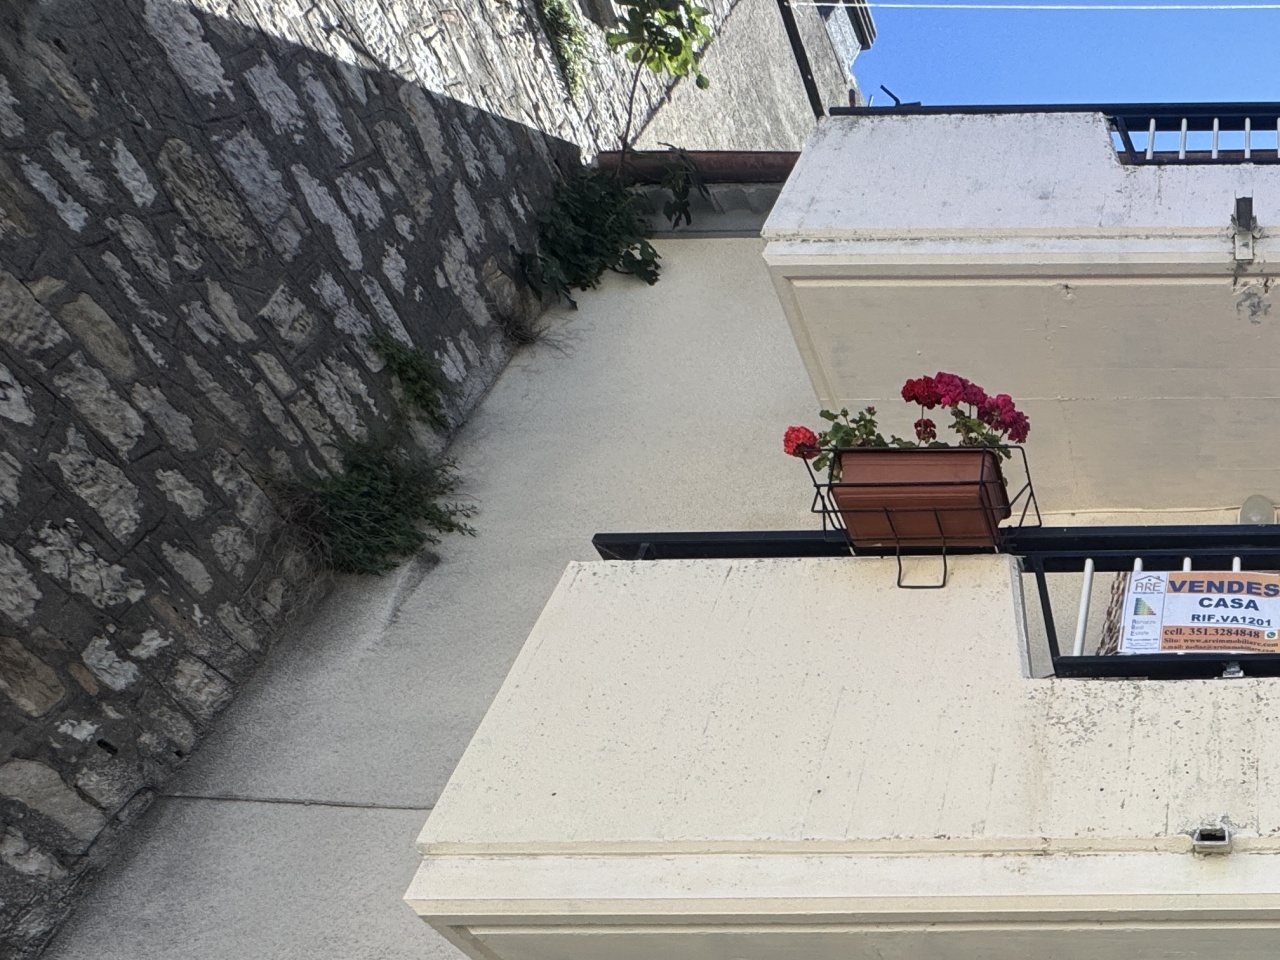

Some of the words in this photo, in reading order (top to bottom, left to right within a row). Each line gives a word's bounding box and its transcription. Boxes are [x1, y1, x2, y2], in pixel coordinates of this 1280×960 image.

[1135, 582, 1162, 591] ARE
[1198, 597, 1260, 611] CASA
[1190, 614, 1272, 627] RIF.VA1201
[1188, 627, 1260, 638] 351.3284848
